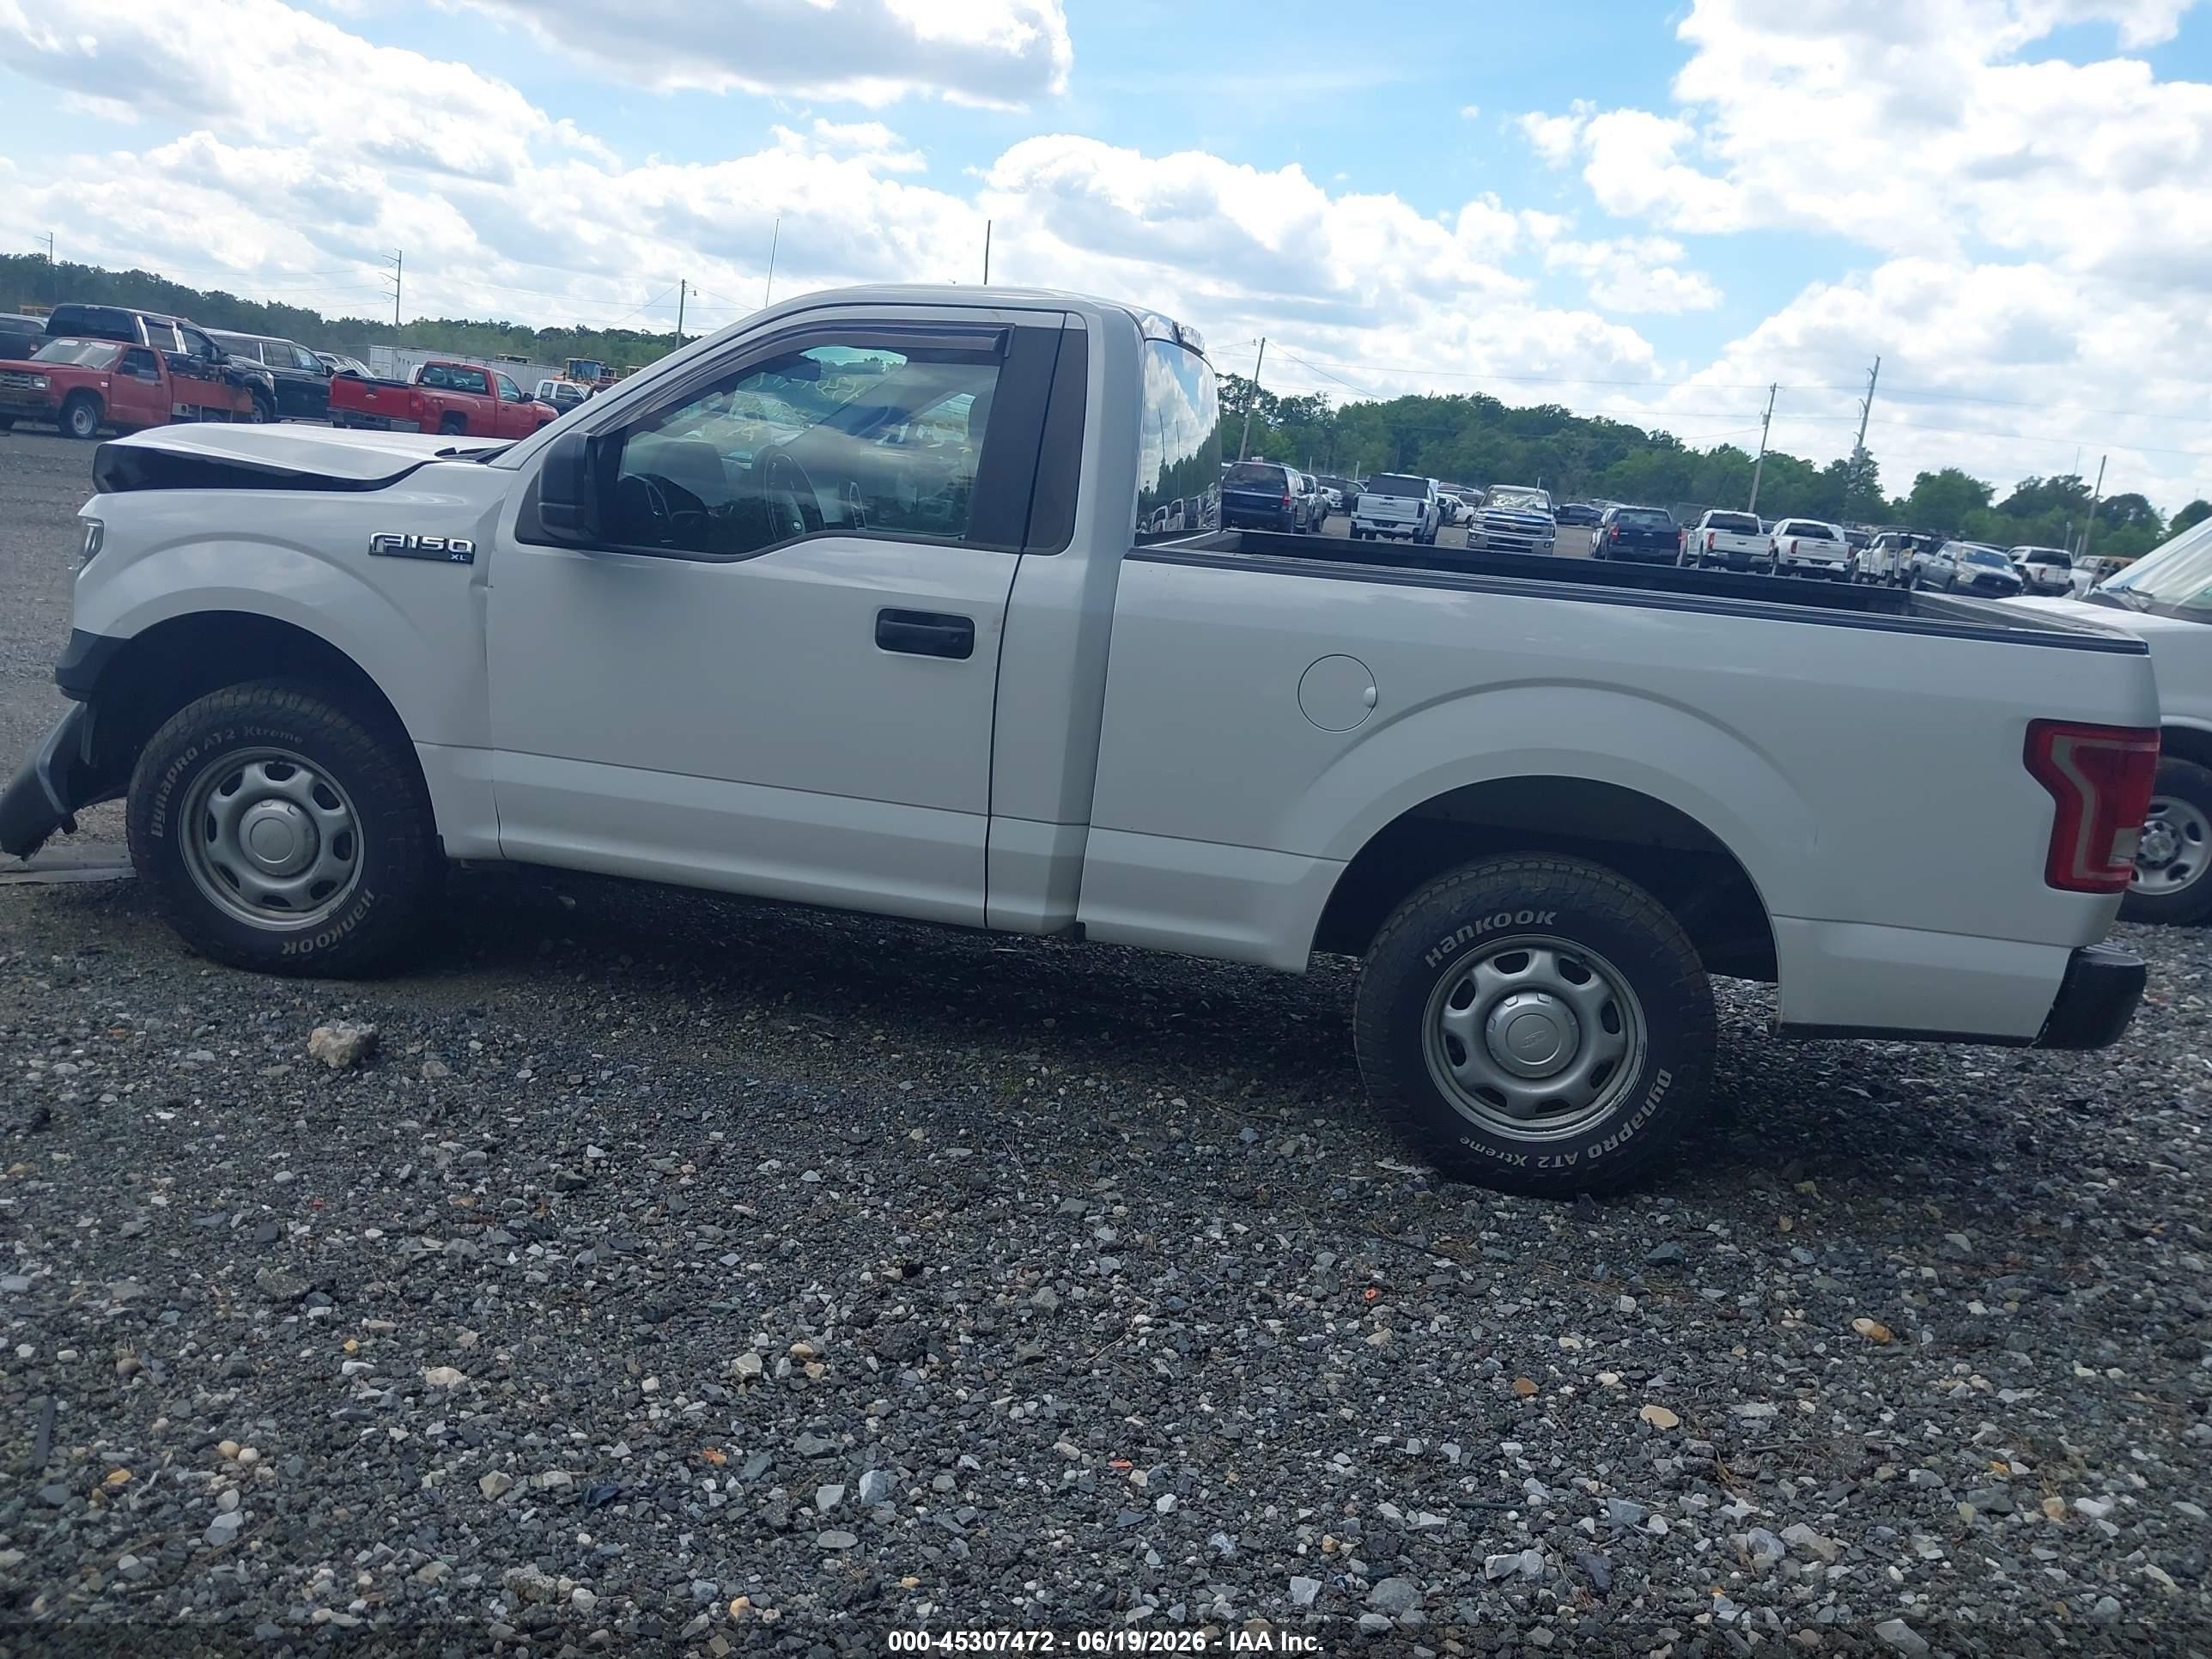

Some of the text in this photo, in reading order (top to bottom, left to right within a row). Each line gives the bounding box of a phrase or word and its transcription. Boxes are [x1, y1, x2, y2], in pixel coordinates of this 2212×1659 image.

[203, 729, 236, 750] AT2
[243, 726, 303, 744] Xtreme
[1459, 1134, 1529, 1168] Xtreme
[1536, 1150, 1580, 1170] AT2
